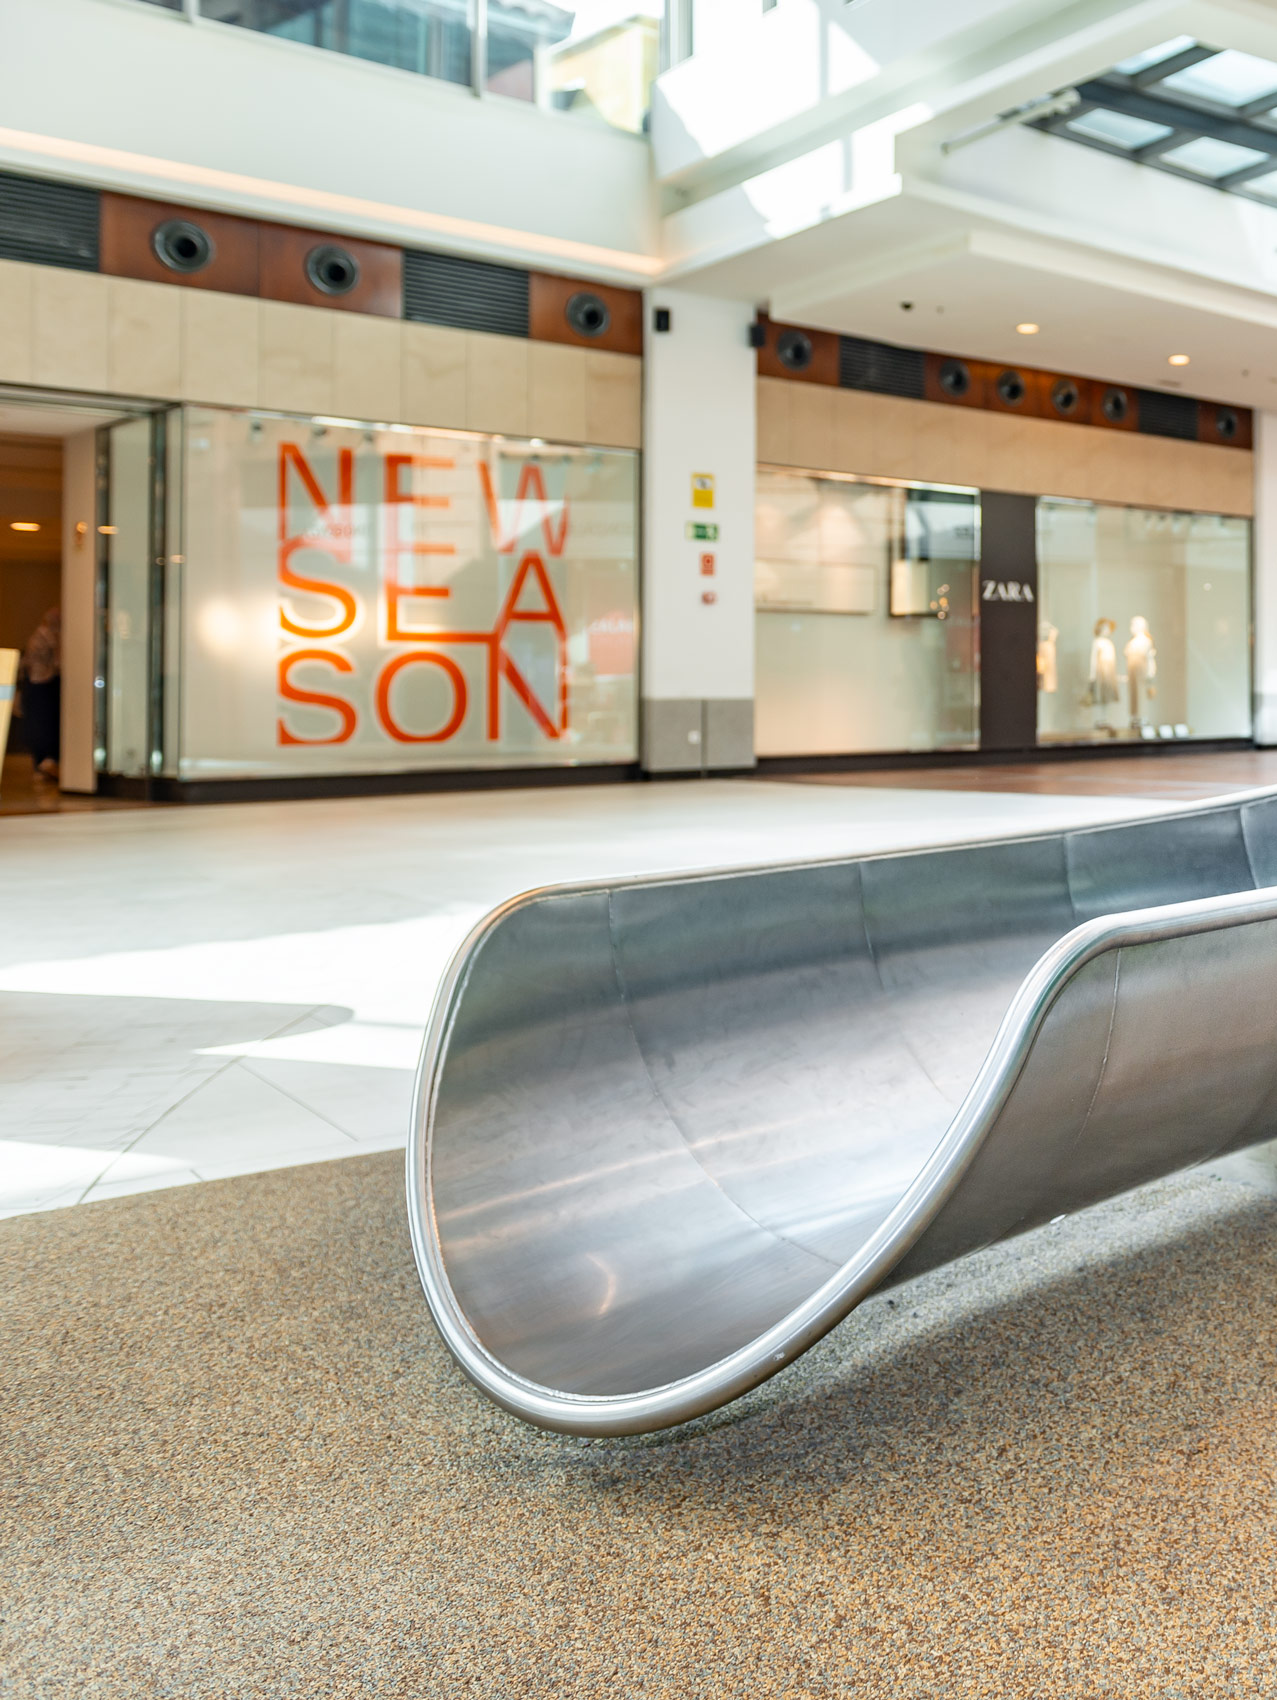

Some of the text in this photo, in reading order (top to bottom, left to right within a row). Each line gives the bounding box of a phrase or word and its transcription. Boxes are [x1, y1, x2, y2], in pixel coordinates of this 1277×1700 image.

[278, 442, 570, 563] NEW
[278, 538, 569, 642] SEA
[982, 579, 1034, 603] ZARA
[277, 648, 570, 746] SON
